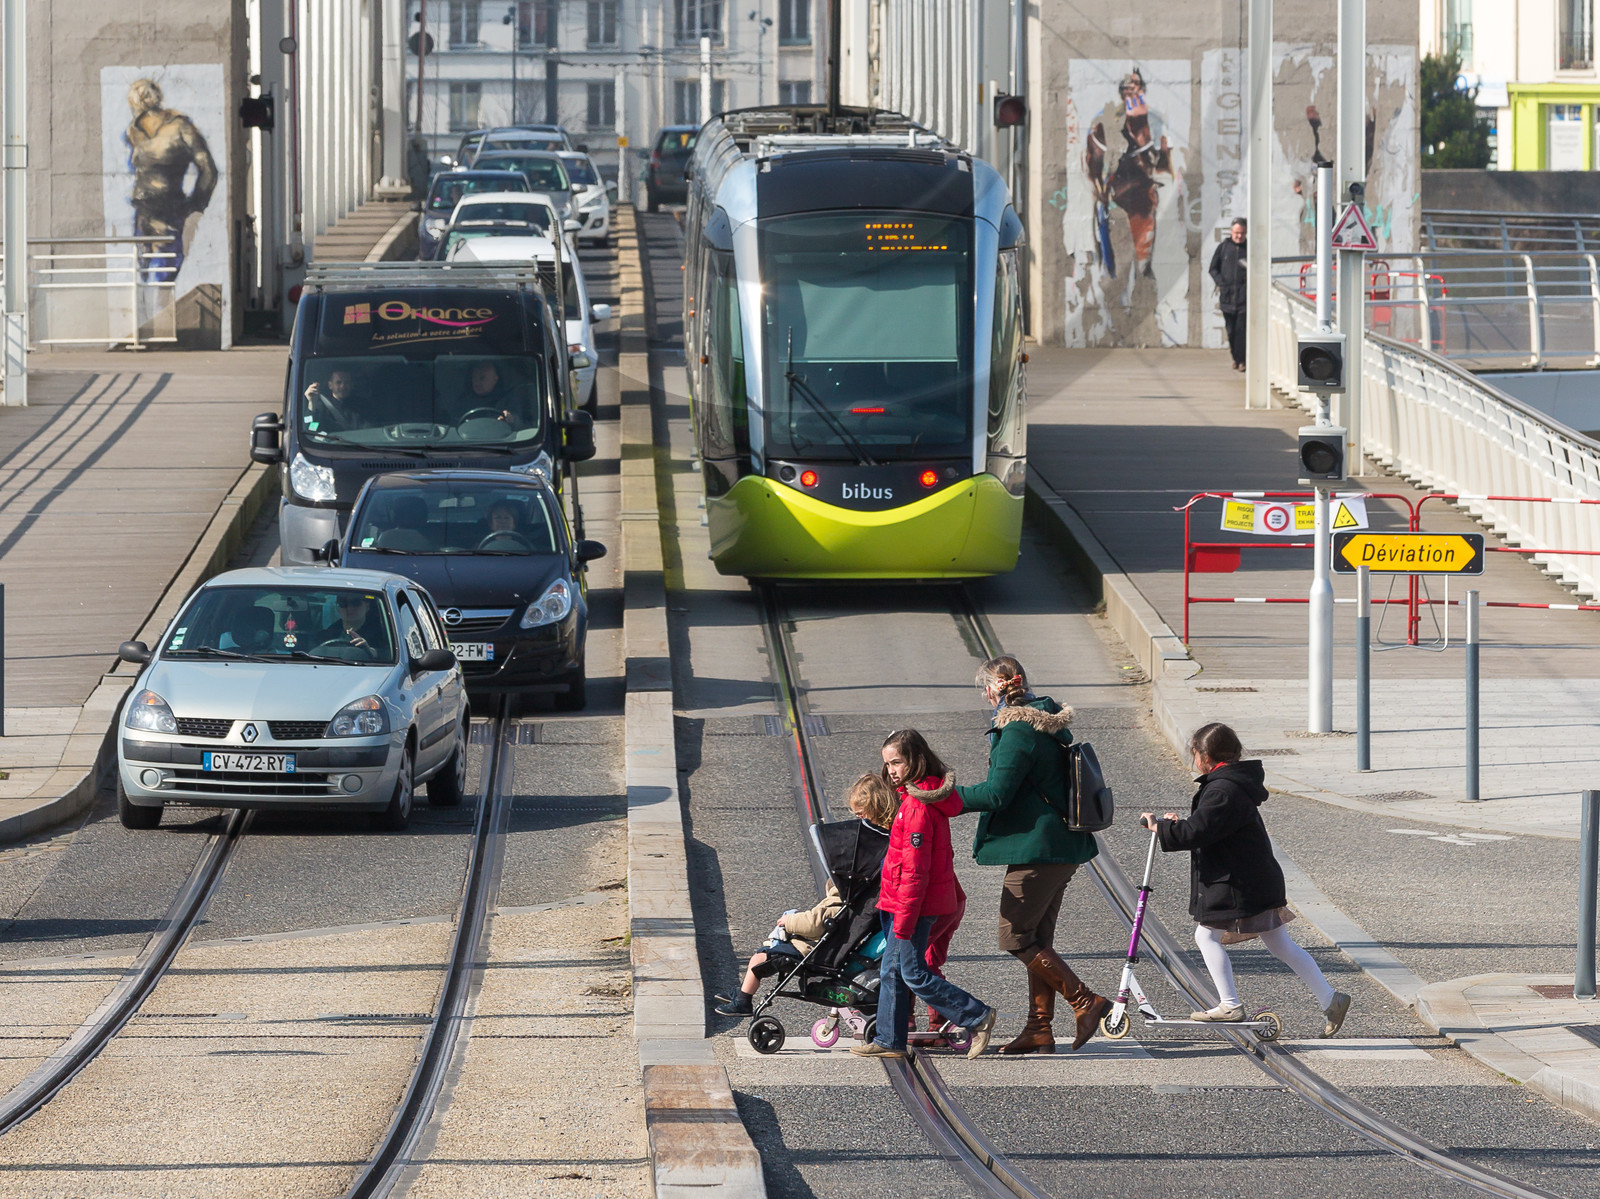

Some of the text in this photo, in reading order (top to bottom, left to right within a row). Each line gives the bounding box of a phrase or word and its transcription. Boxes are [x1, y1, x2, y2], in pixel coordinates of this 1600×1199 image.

[378, 300, 493, 321] Oriance
[842, 482, 894, 500] bibus
[1362, 543, 1455, 563] Déviation
[212, 754, 285, 771] CV-472-RY
